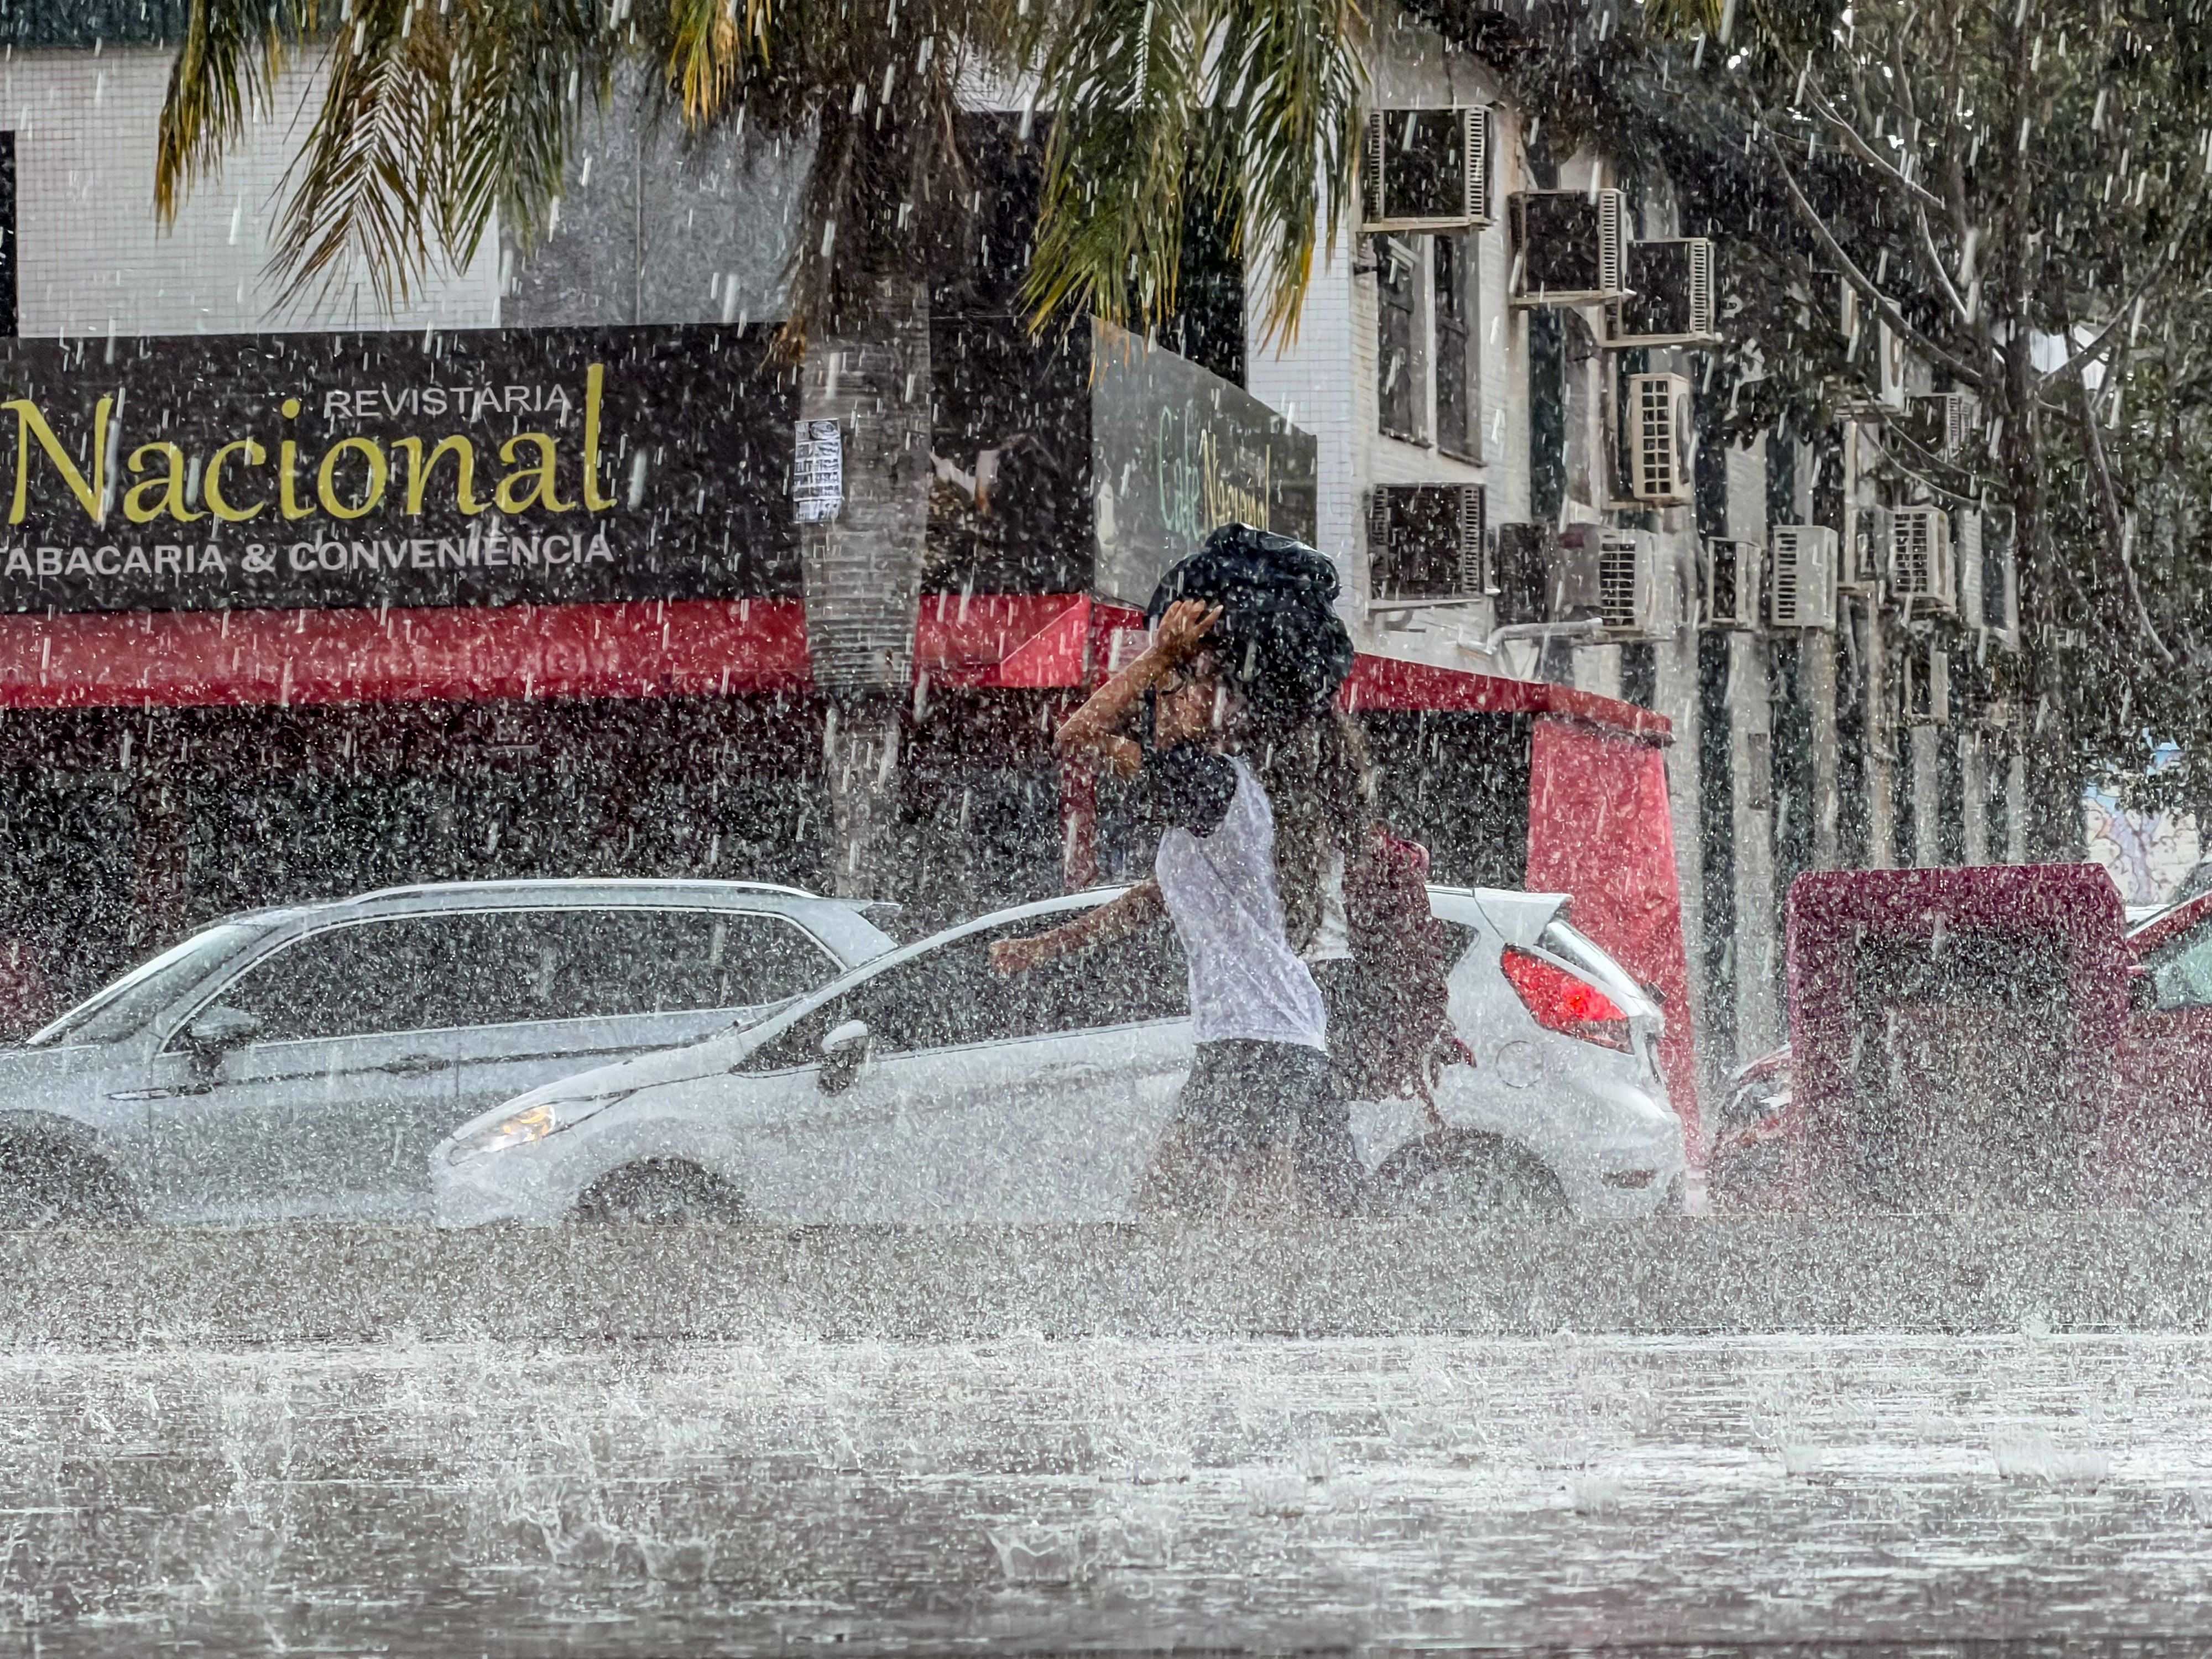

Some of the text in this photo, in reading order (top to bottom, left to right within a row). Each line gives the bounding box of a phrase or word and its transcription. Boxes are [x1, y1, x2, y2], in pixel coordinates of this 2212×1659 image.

[0, 363, 618, 525] Nacional
[0, 544, 225, 576] ABACARIA
[241, 544, 275, 572] &
